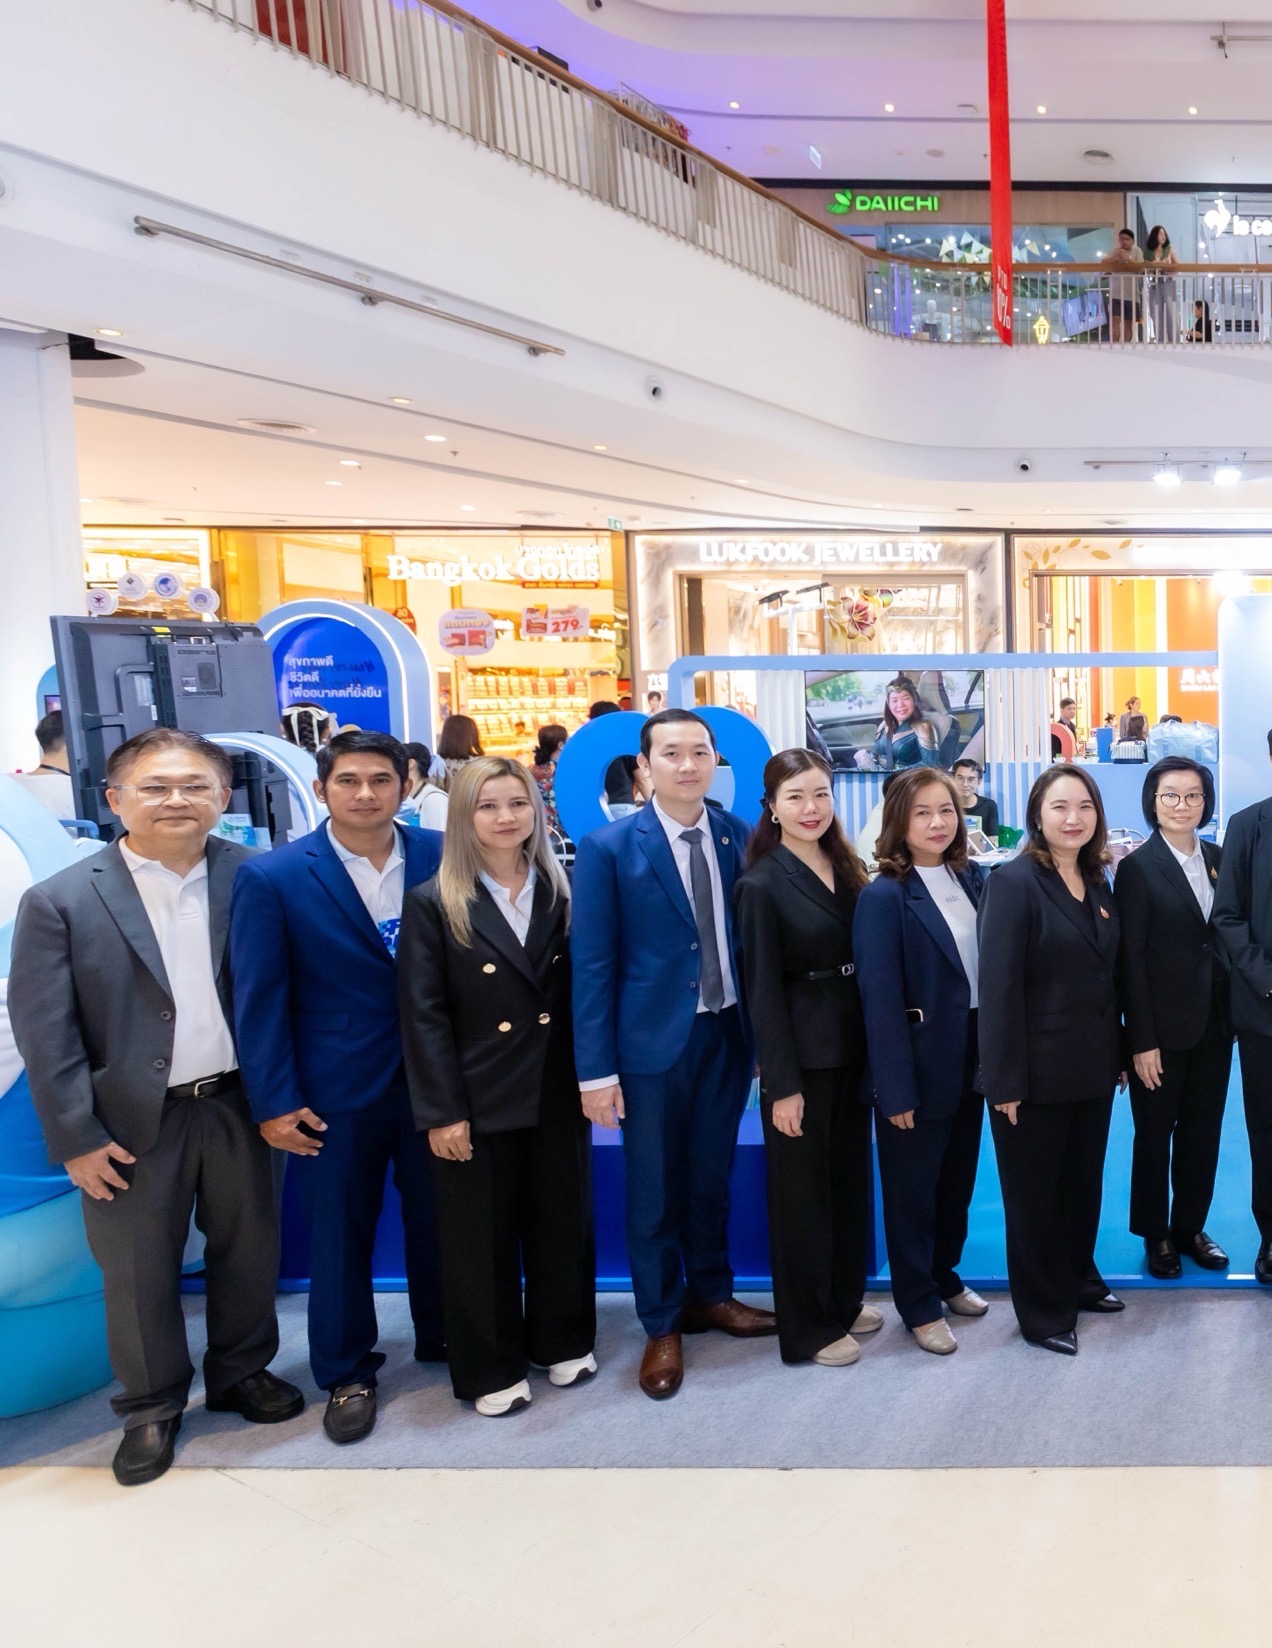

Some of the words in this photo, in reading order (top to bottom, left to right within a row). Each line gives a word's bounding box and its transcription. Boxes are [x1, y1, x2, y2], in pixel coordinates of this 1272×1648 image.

[855, 195, 939, 211] DAIICHI
[1233, 215, 1249, 235] le
[699, 542, 809, 562] LUKFOOK
[812, 542, 942, 566] JEWELLERY
[386, 555, 515, 586] Bangkok
[516, 554, 600, 580] Golds
[289, 655, 333, 669] สุขภาพดี
[290, 671, 319, 682] ชีวิตดี
[290, 684, 382, 698] เพื่ออนาคตที่ยั่งยืน
